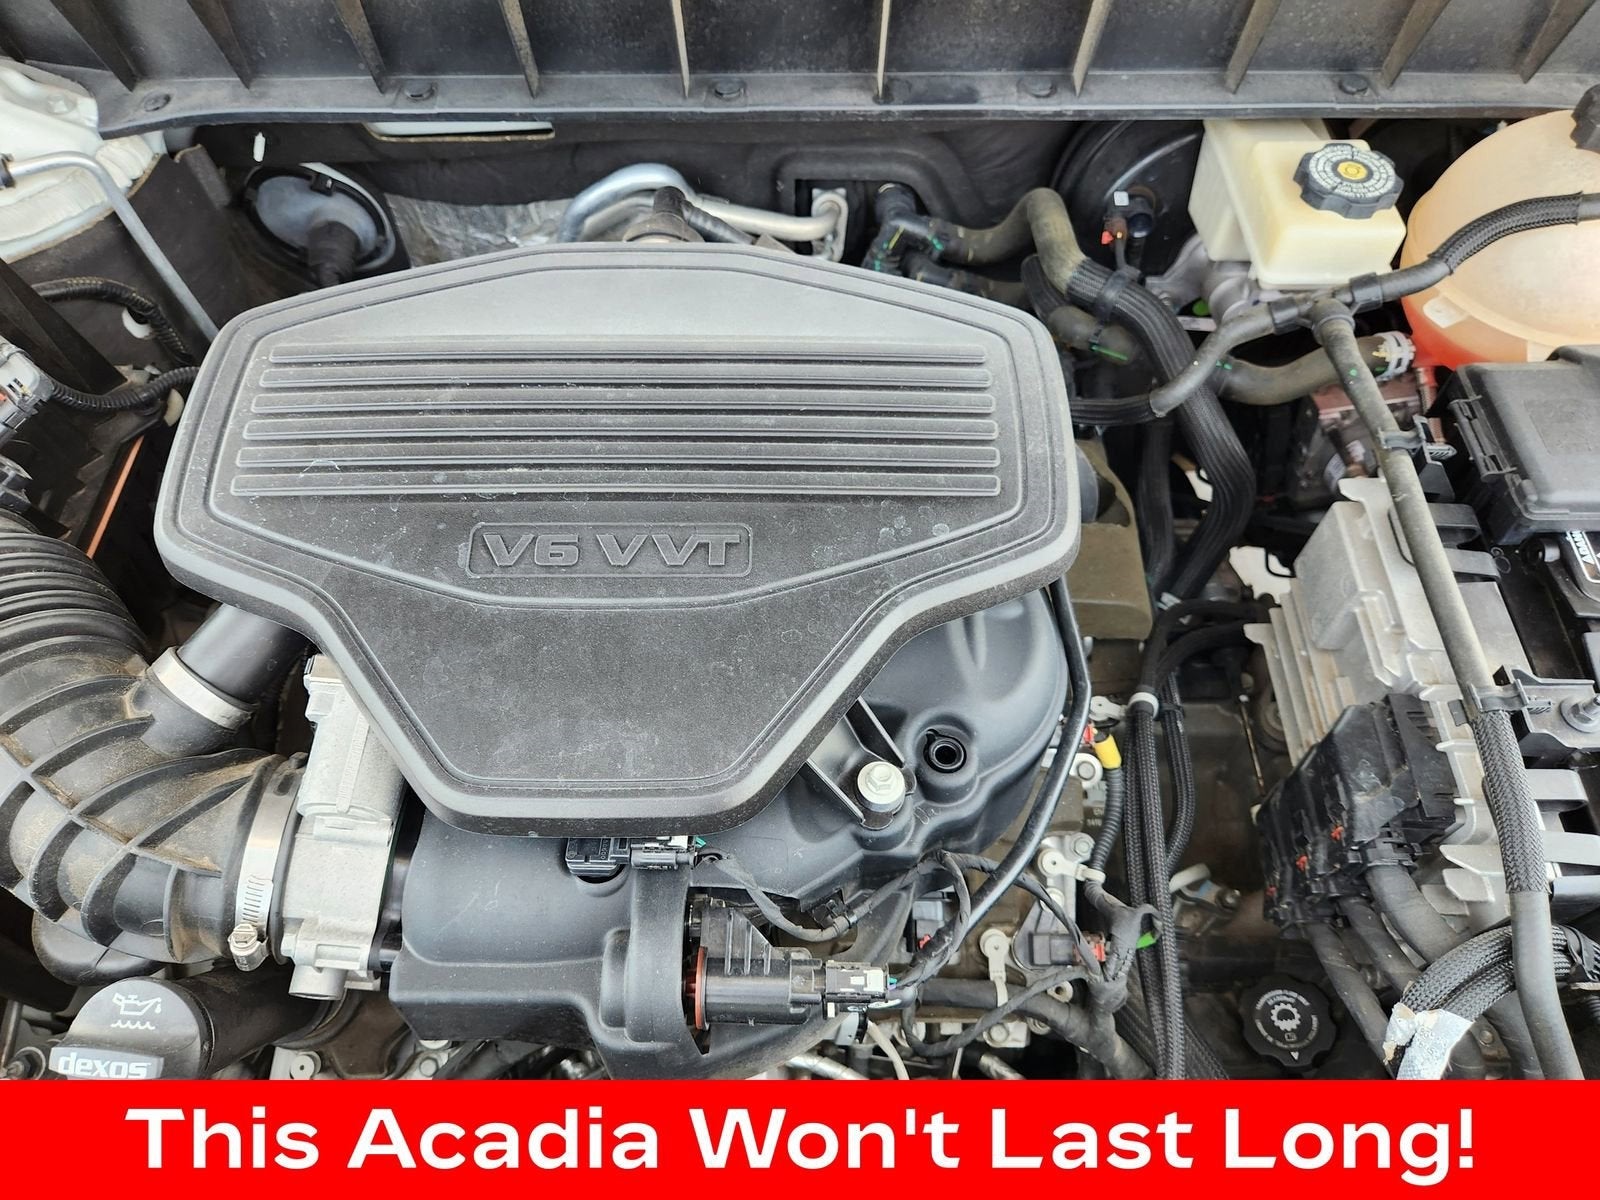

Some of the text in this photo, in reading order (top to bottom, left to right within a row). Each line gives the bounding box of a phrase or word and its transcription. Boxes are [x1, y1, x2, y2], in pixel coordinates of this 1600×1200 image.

[483, 533, 741, 566] V6 VVT
[59, 1052, 149, 1079] dexos
